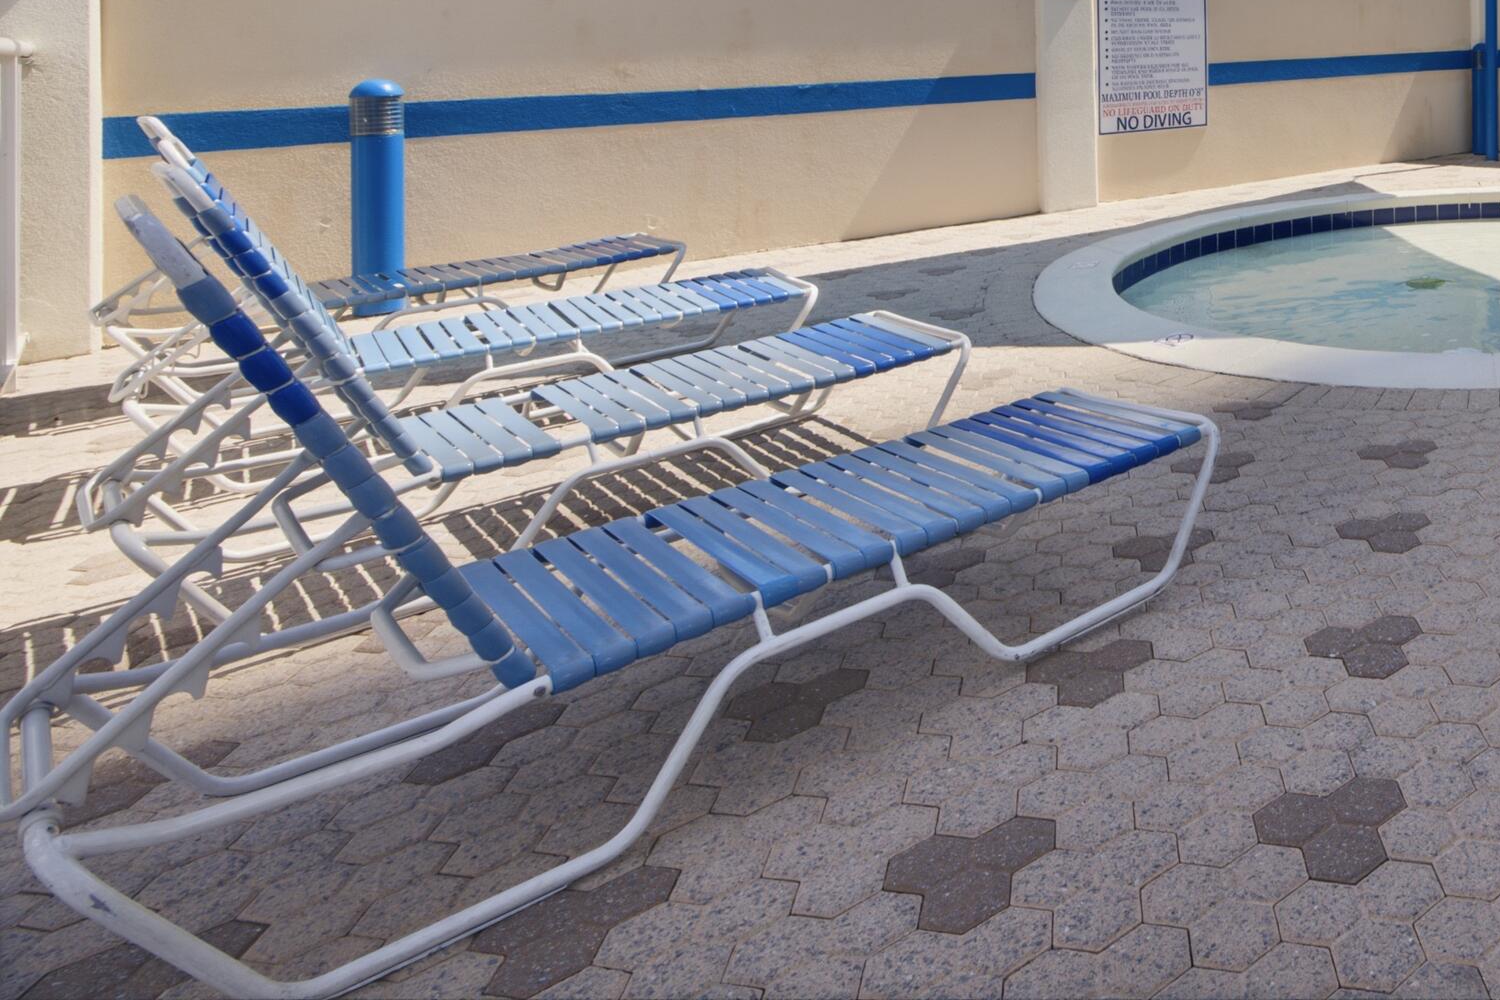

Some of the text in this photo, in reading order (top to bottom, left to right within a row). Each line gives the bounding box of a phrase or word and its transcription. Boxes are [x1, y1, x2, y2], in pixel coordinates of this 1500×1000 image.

[1102, 91, 1141, 103] MAXIMUM
[1143, 90, 1162, 100] POOL
[1164, 88, 1188, 99] DEPTH
[1103, 108, 1116, 118] NO
[1117, 105, 1167, 117] LIFEGUARD
[1167, 104, 1180, 113] ON
[1182, 102, 1203, 112] DUTY
[1116, 111, 1192, 131] NO DIVING
